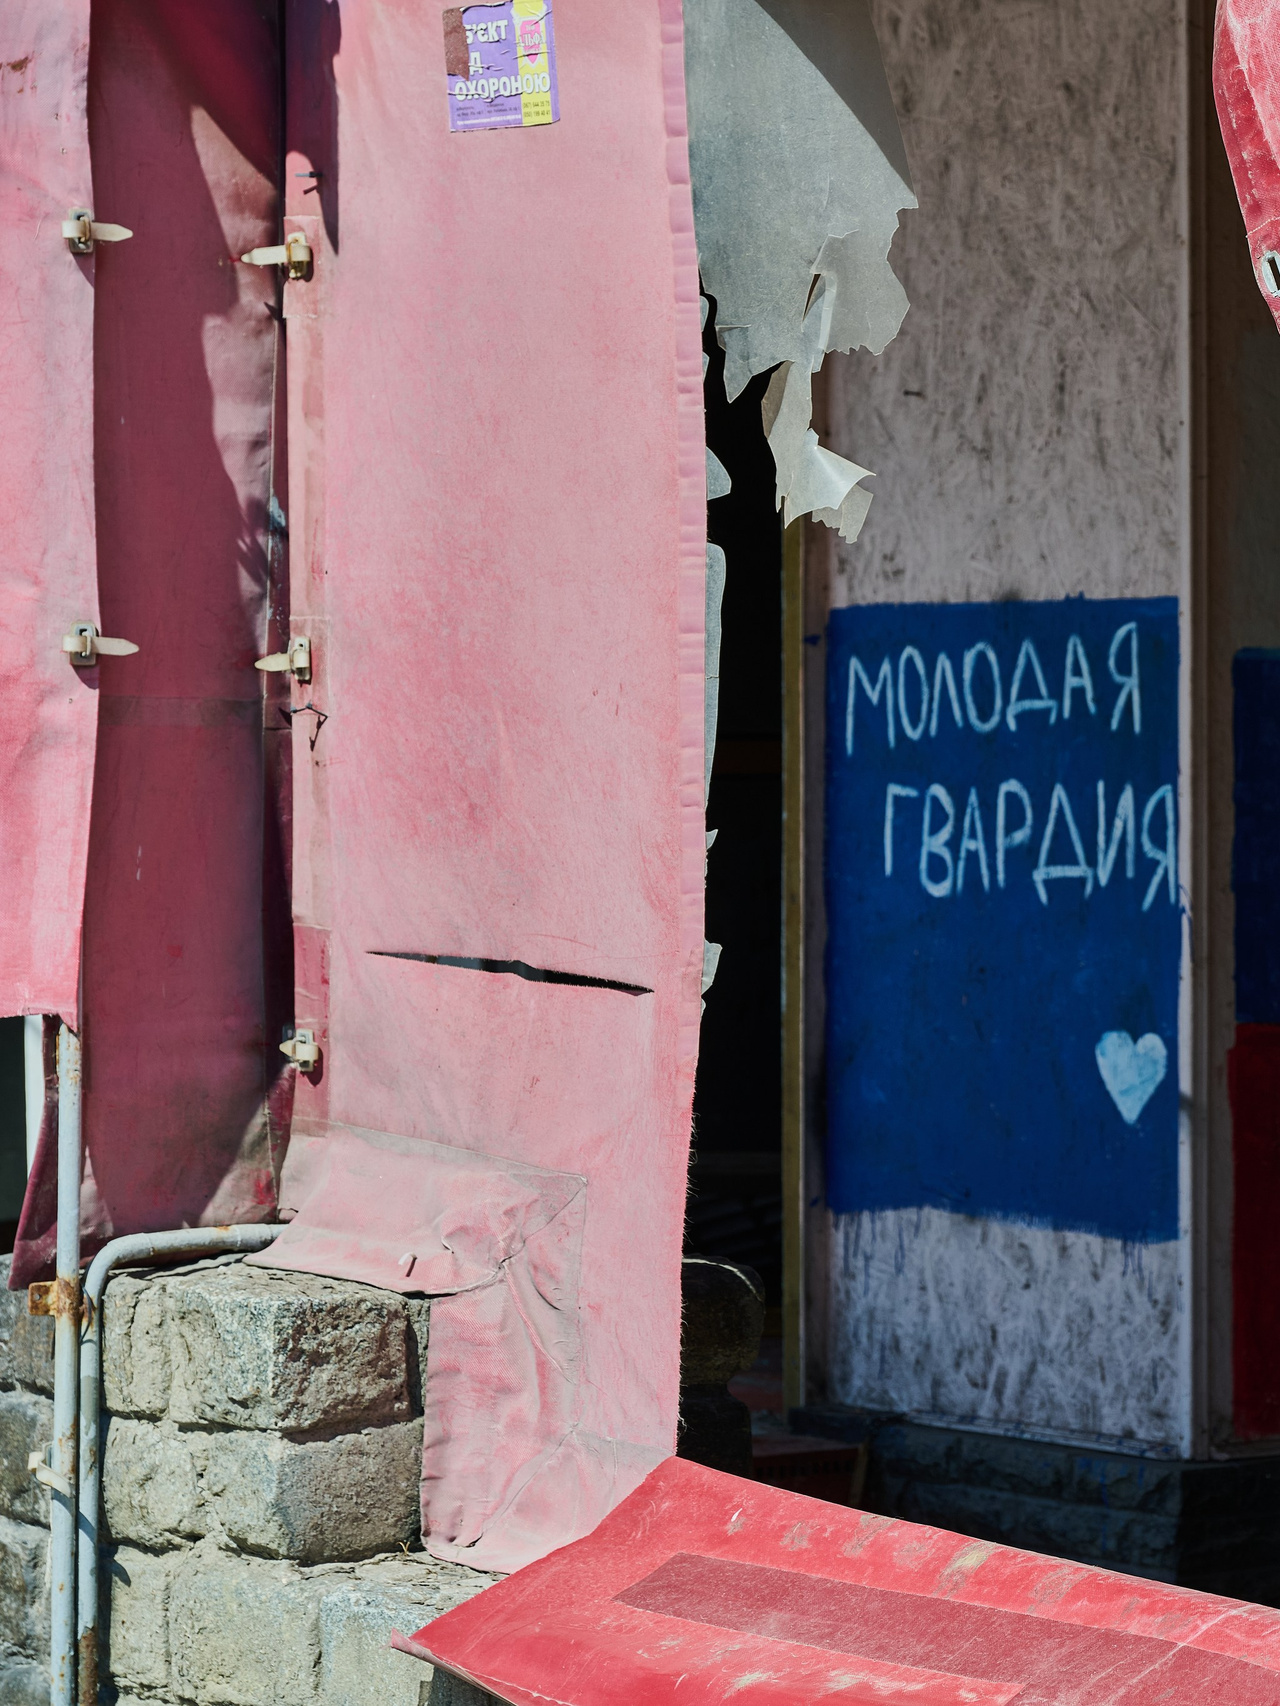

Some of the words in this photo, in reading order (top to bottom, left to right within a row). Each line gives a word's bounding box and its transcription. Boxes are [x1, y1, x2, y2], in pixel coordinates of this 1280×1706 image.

[454, 72, 551, 101] ОХОРОНОЮ
[845, 620, 1141, 759] МОЛОДАЯ
[883, 778, 1177, 912] ГВАРДИЯ
